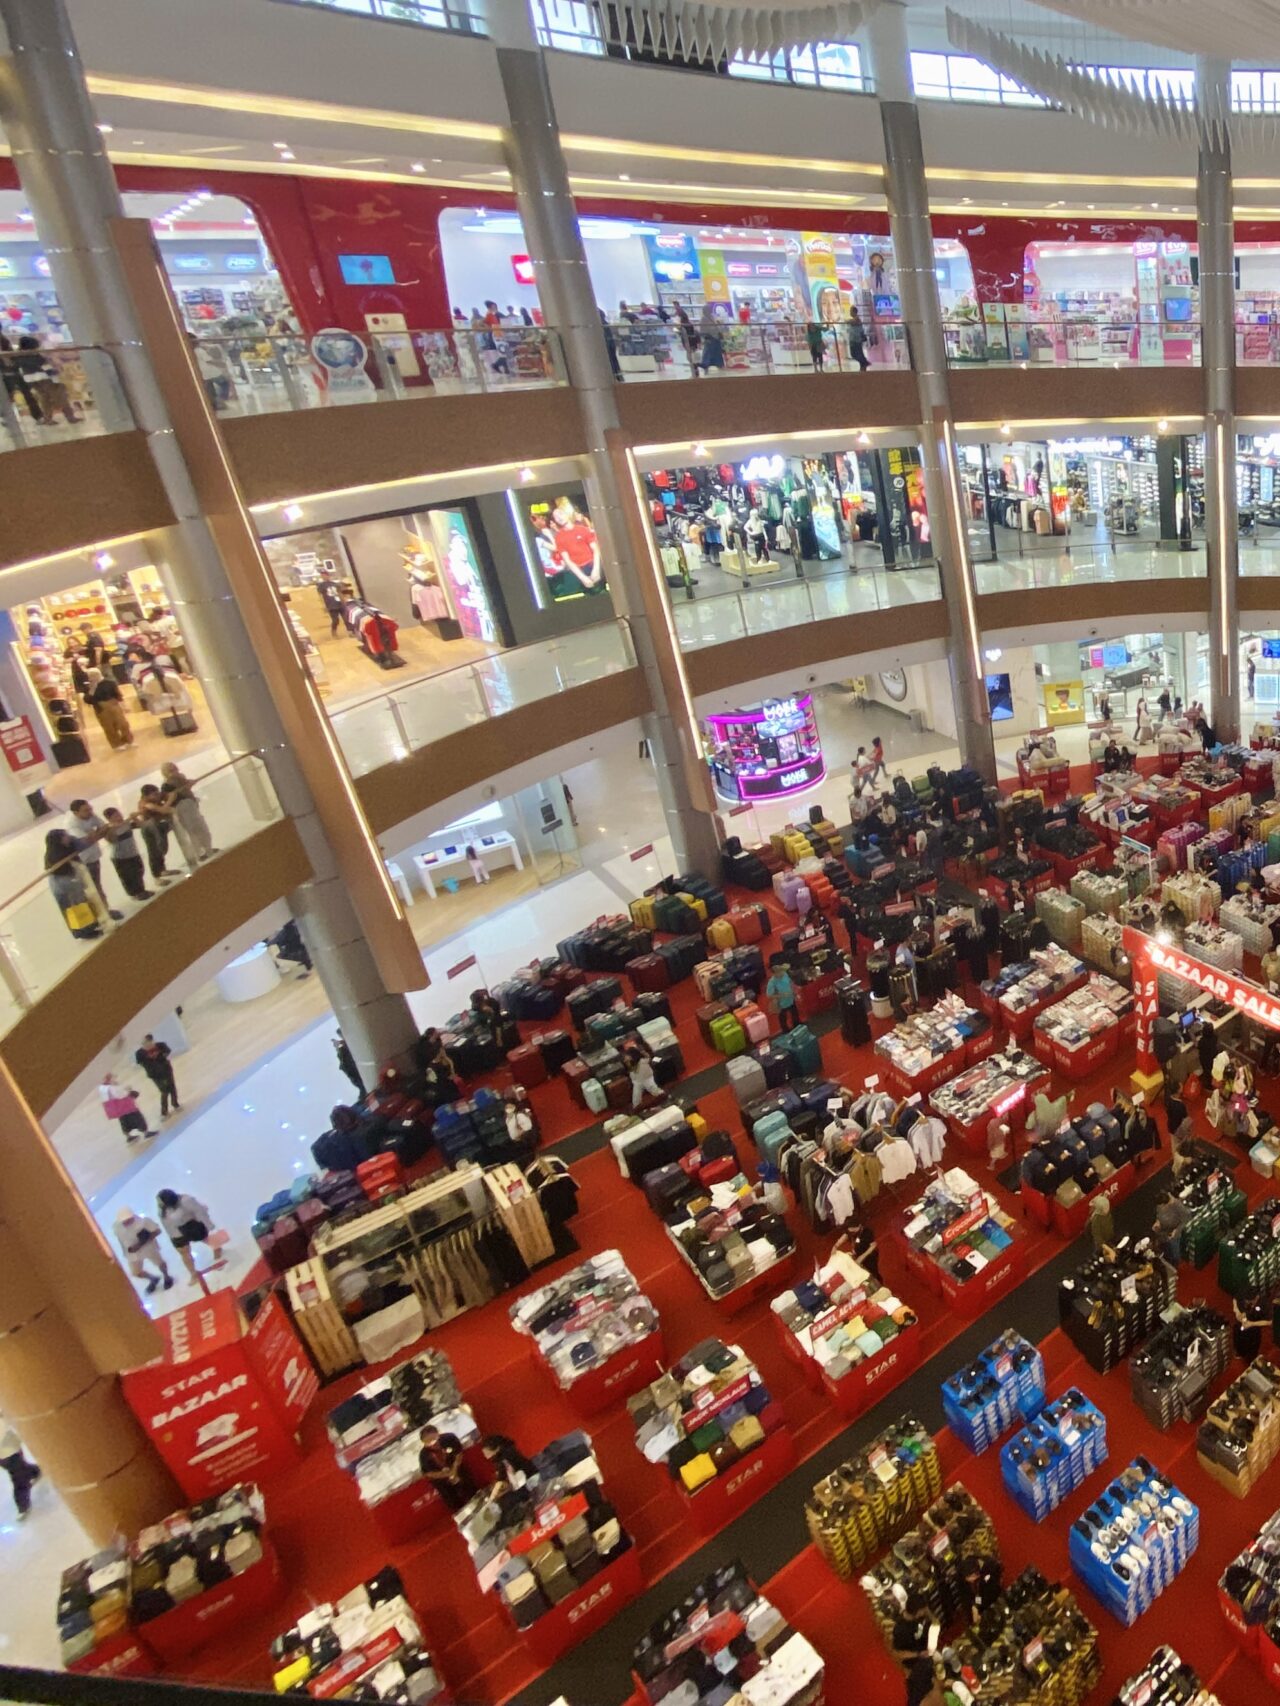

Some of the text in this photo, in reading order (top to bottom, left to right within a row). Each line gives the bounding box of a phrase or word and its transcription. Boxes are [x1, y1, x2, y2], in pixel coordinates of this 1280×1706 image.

[1150, 949, 1229, 998] BAZAAR
[1134, 981, 1145, 1052] SALE
[932, 1064, 953, 1083] STAR
[986, 1263, 1011, 1290] STAR
[812, 1315, 839, 1335] CAMEL
[160, 1366, 217, 1400] STAR
[865, 1353, 898, 1386] STAR
[151, 1373, 249, 1430] BAZAAR
[726, 1460, 763, 1495] STAR
[568, 1582, 613, 1625] STAR
